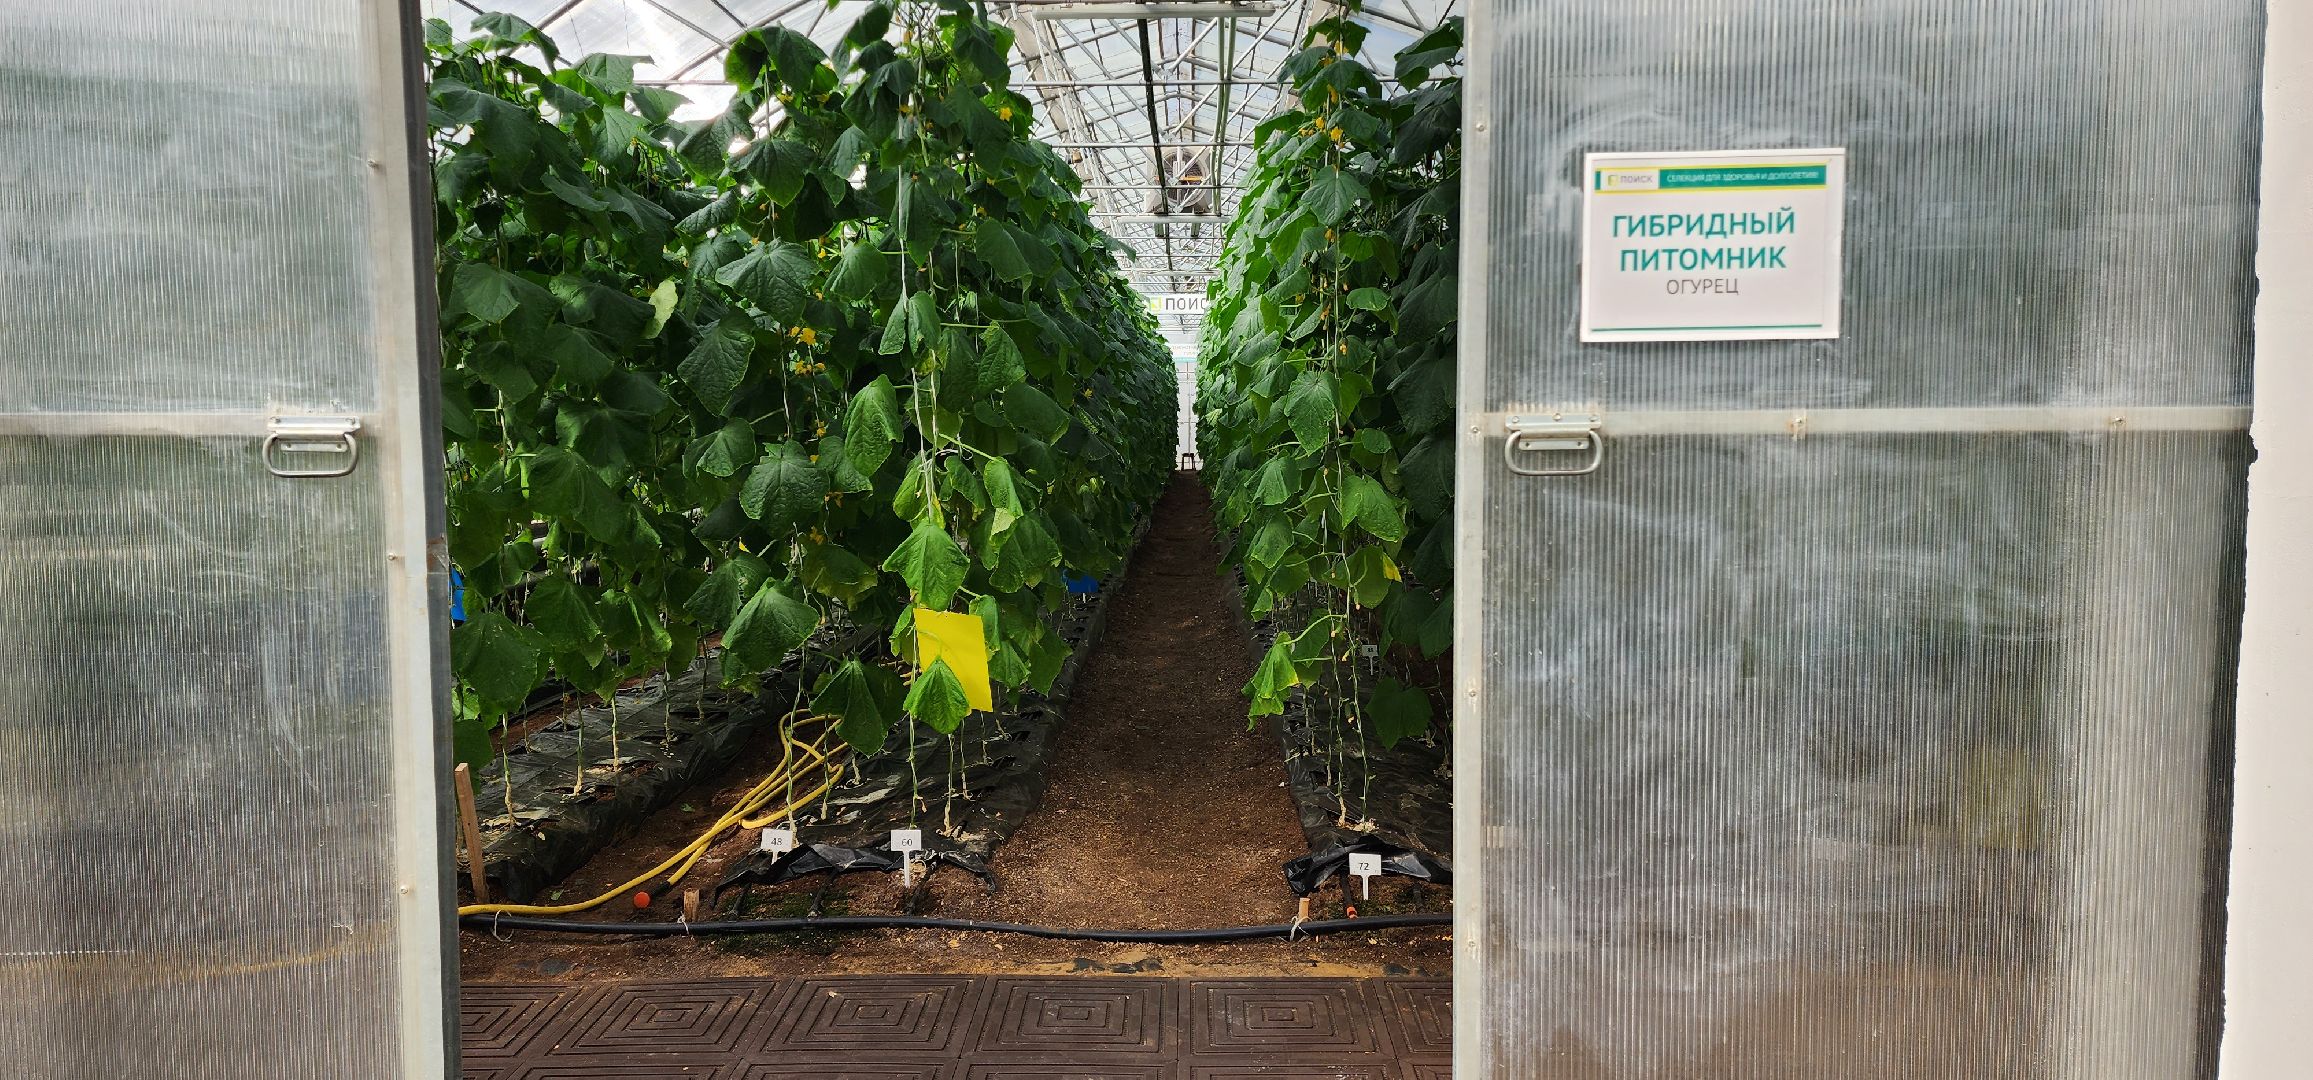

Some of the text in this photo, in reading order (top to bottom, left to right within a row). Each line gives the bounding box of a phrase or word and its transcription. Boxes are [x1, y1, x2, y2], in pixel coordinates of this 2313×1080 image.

[1620, 175, 1652, 184] ПОИСК
[1612, 206, 1796, 239] ГИБРИДНЫЙ
[1620, 245, 1787, 272] ПИТОМНИК
[1666, 277, 1739, 296] ОГУРЕЦ
[1166, 297, 1206, 310] ПОИС
[771, 837, 783, 846] 48
[901, 838, 913, 847] 60
[1358, 862, 1370, 870] 72
